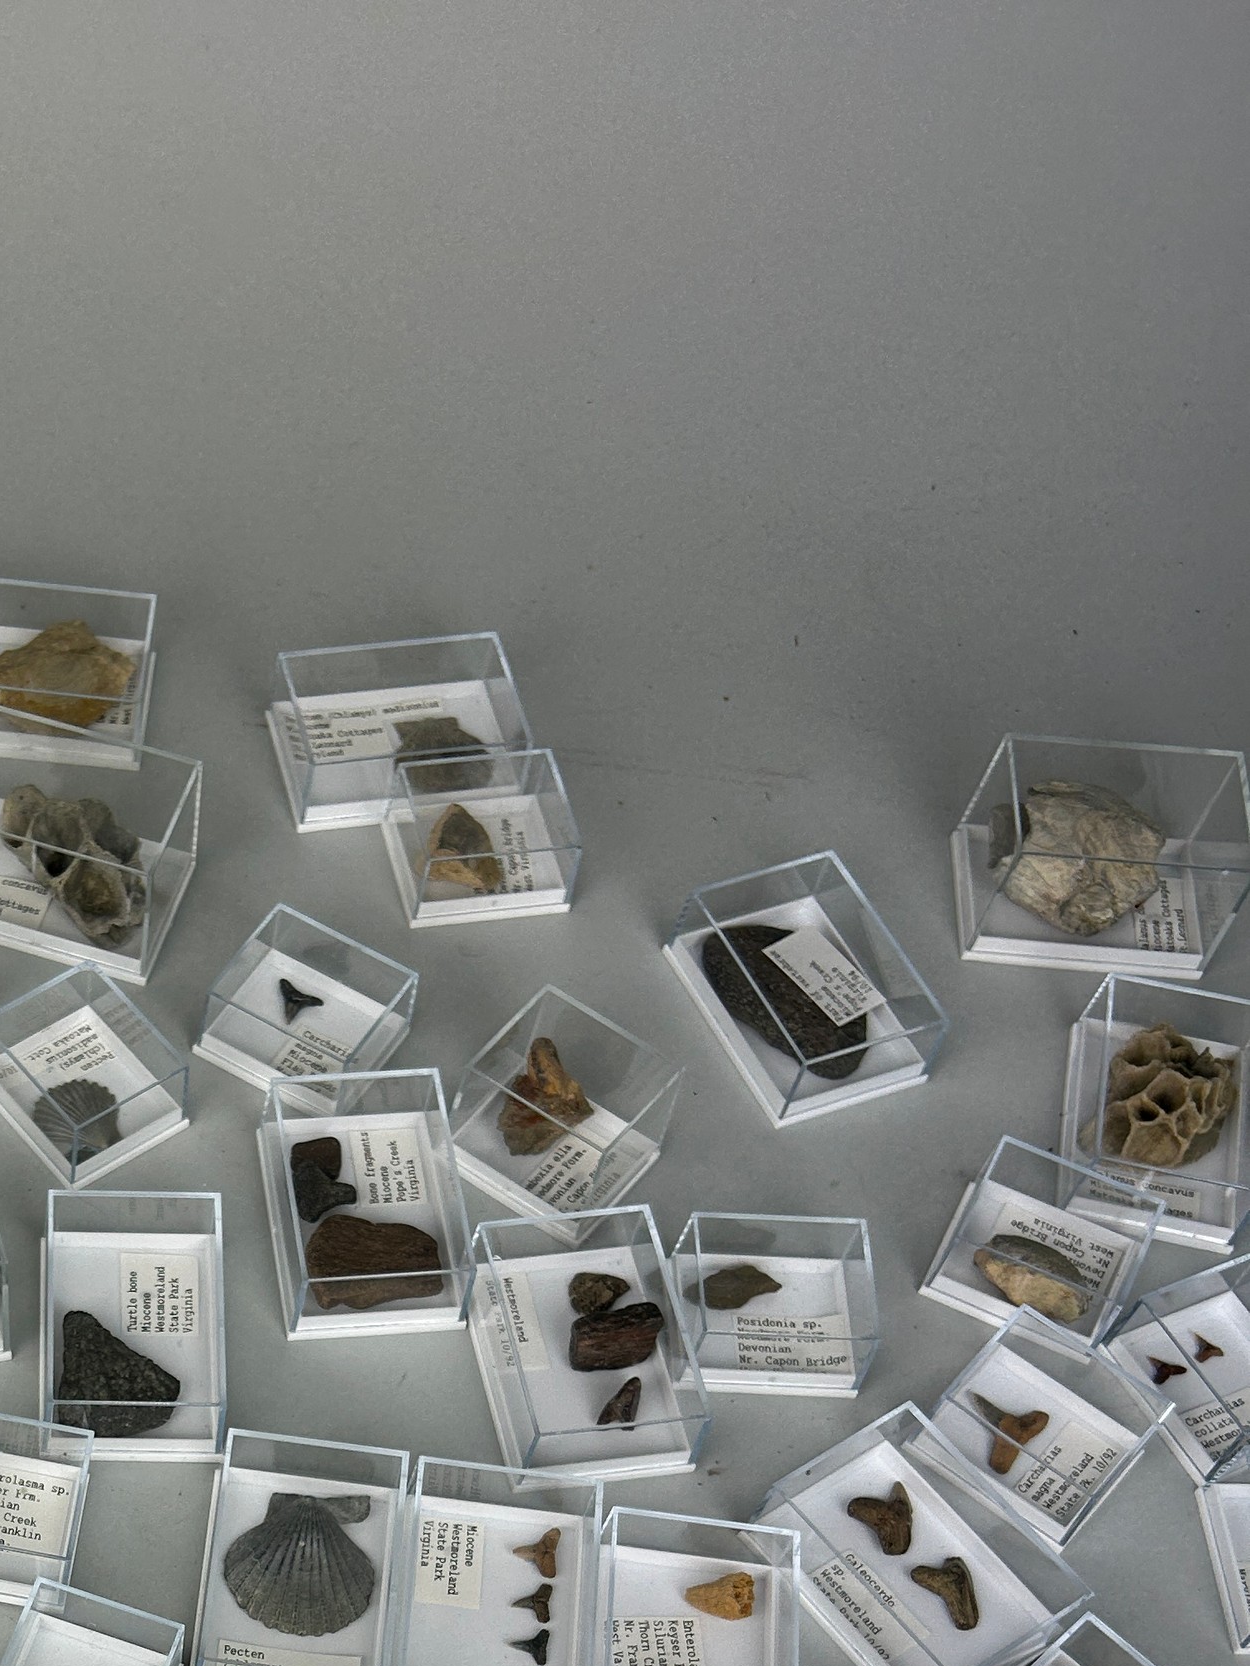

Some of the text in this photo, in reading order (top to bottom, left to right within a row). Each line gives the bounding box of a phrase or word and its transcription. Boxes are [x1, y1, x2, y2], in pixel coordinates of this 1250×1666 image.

[379, 1165, 393, 1203] Miocene
[404, 1158, 420, 1202] Virginia
[140, 1291, 151, 1332] Miocene
[153, 1265, 165, 1333] Westmoreland
[181, 1287, 194, 1333] Virginia
[736, 1316, 822, 1330] Posidonia sp.
[737, 1341, 792, 1353] Devonian
[2, 1511, 37, 1527] Creek
[419, 1520, 434, 1567] Virginia
[446, 1523, 462, 1595] Westmoreland
[463, 1524, 478, 1567] Miocene
[223, 1643, 265, 1660] Pecten
